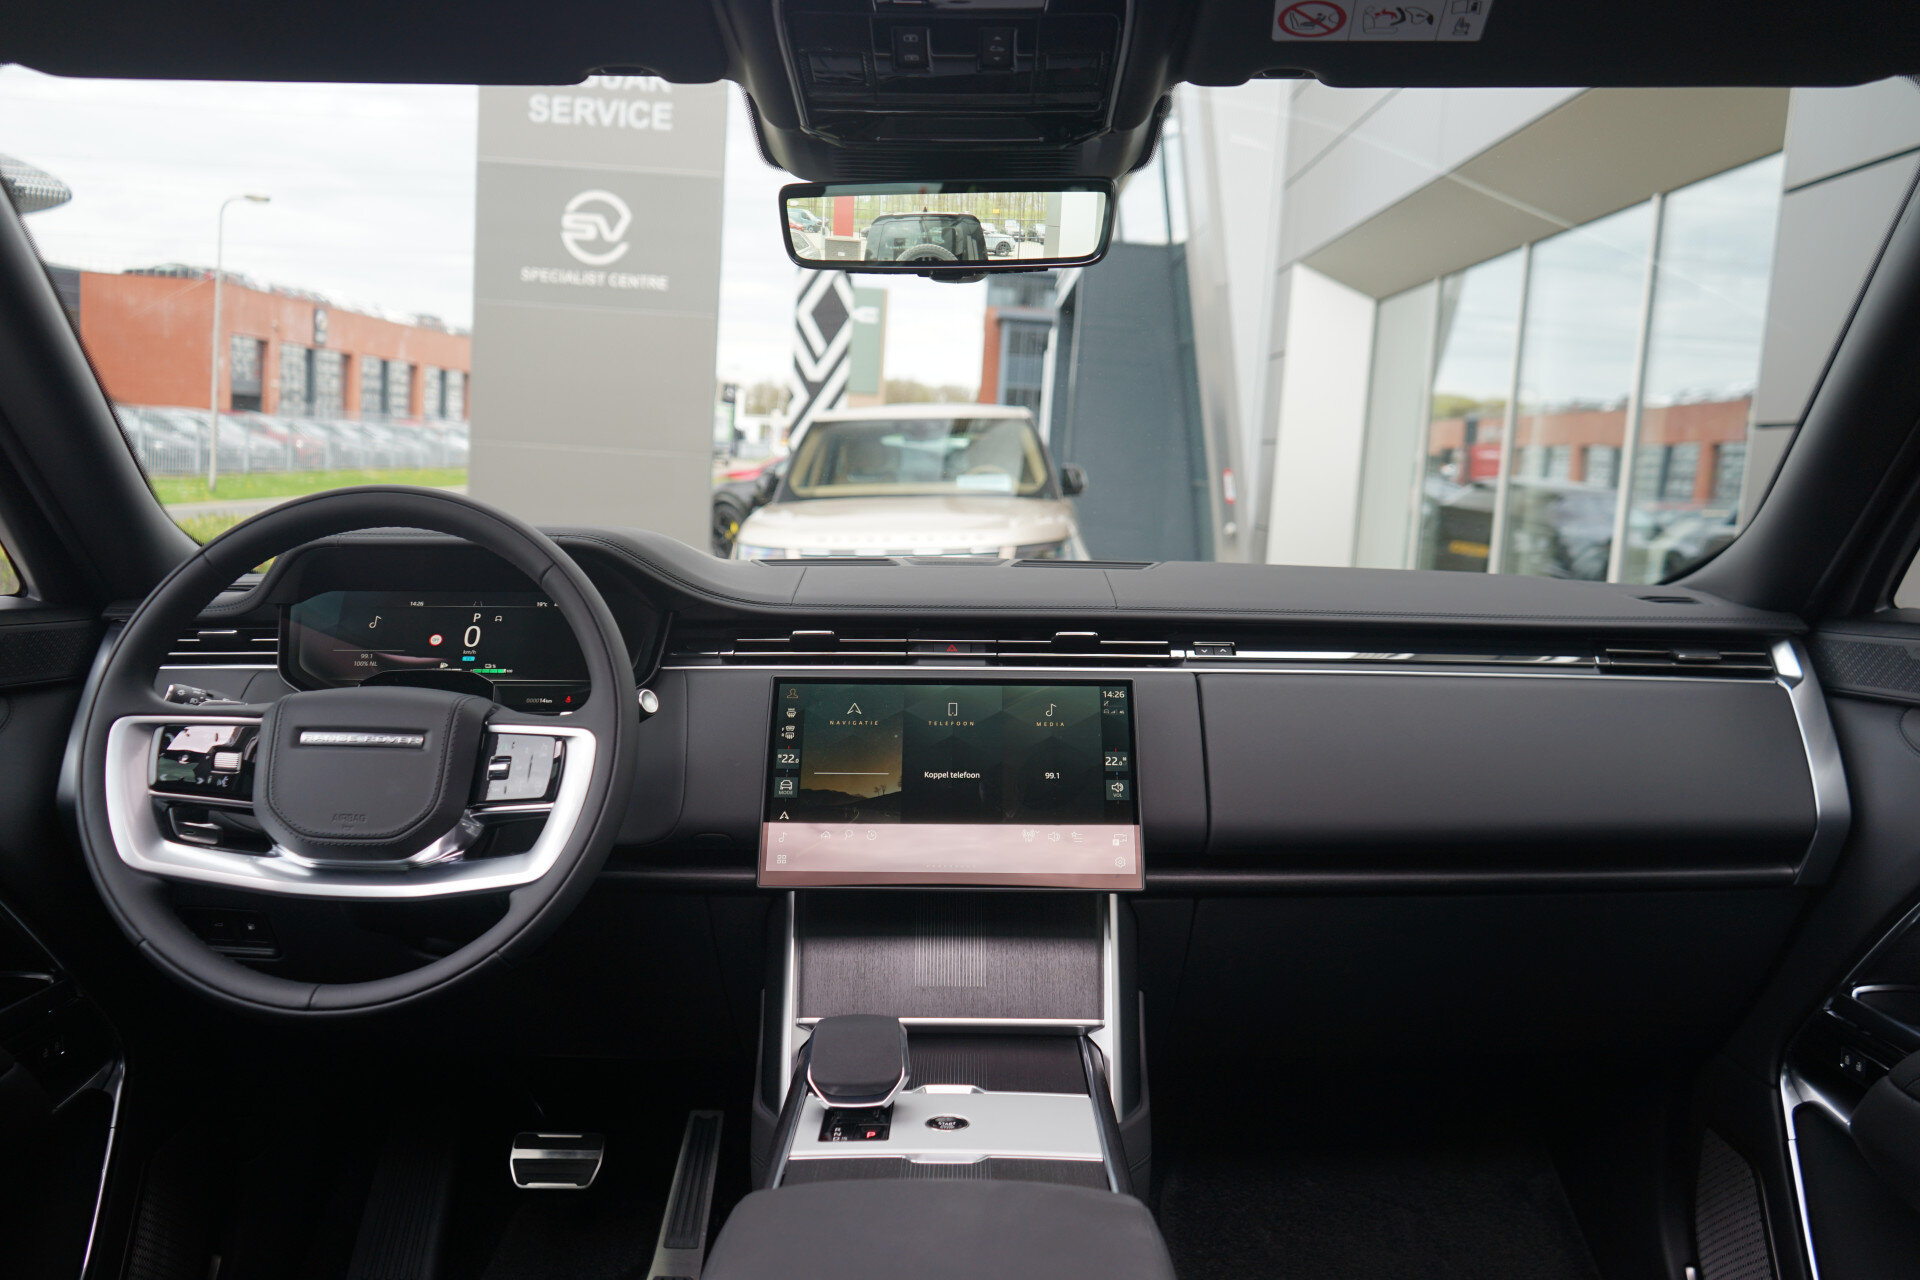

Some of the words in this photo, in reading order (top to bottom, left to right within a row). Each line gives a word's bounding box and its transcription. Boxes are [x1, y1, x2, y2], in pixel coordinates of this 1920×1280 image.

[528, 93, 674, 131] SERVICE
[520, 266, 606, 286] SPECIALIST
[608, 272, 669, 291] CENTRE
[473, 612, 482, 623] P
[464, 625, 481, 648] 0
[1102, 690, 1125, 698] 14:26
[364, 736, 423, 745] ROVER
[924, 771, 949, 779] Koppel
[950, 771, 980, 779] telefoon
[866, 1131, 876, 1139] P
